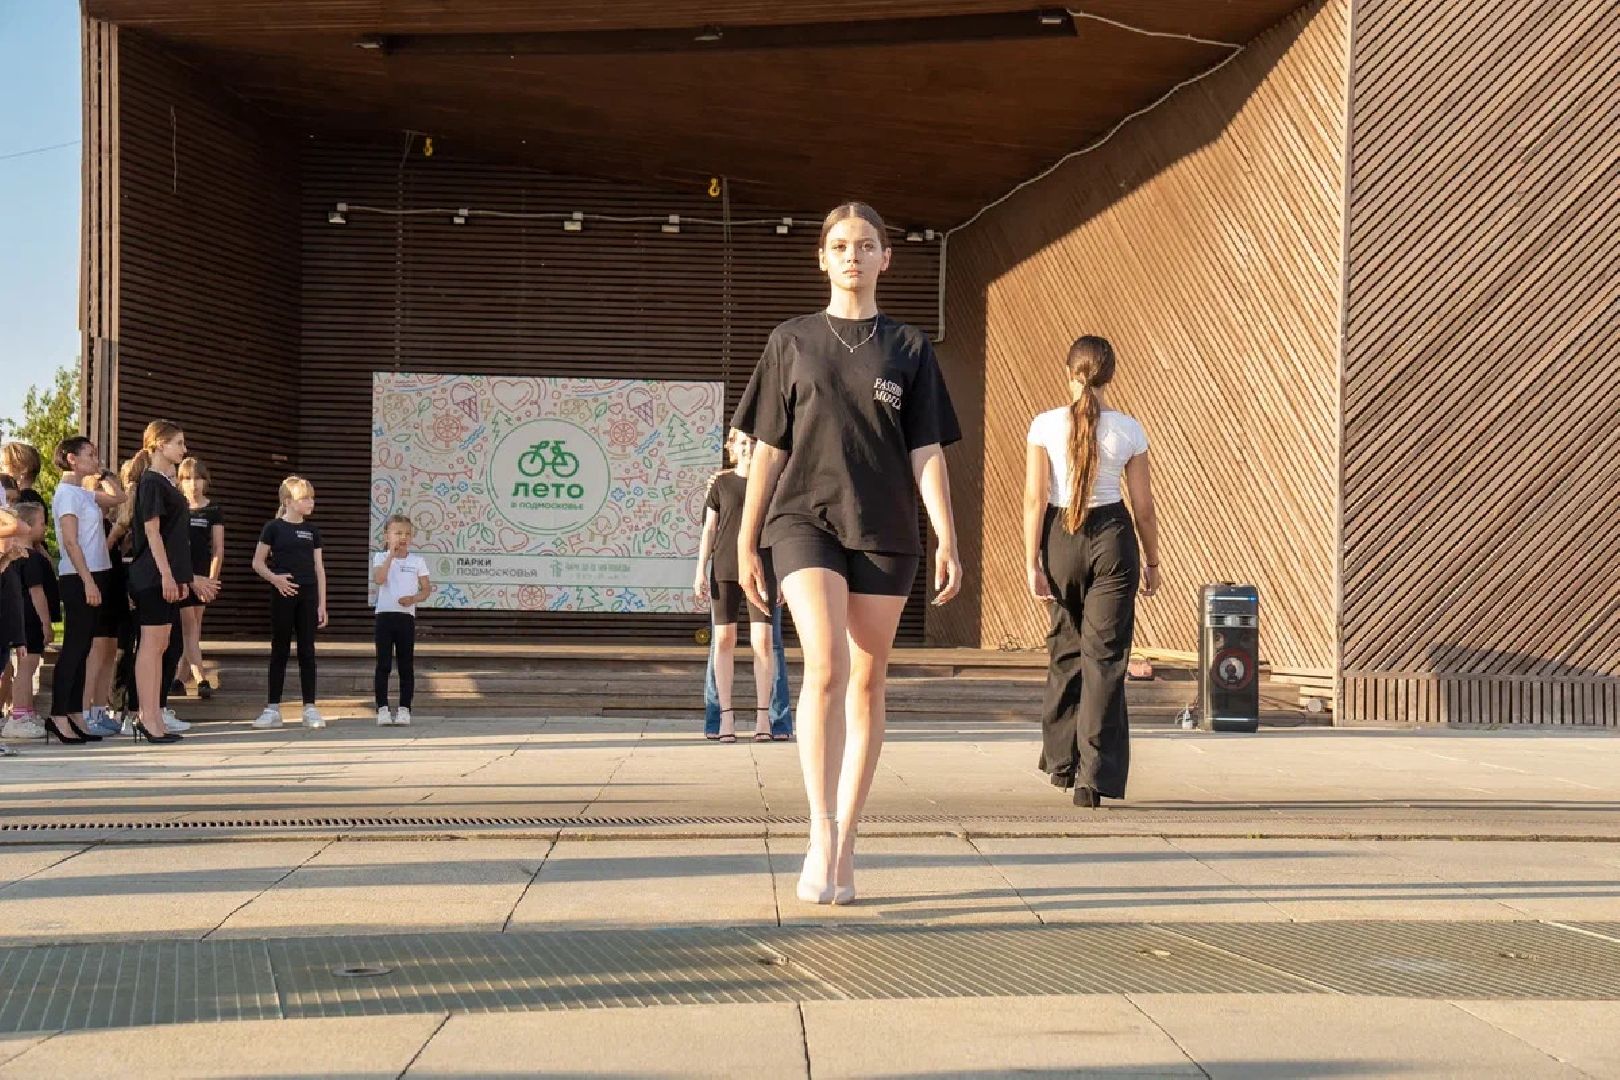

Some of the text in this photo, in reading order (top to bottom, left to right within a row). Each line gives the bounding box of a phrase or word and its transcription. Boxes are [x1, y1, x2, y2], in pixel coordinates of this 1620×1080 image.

[512, 482, 585, 499] лето
[456, 557, 492, 566] ПАРКИ
[456, 567, 538, 578] ПОДМОСКОВЬЯ
